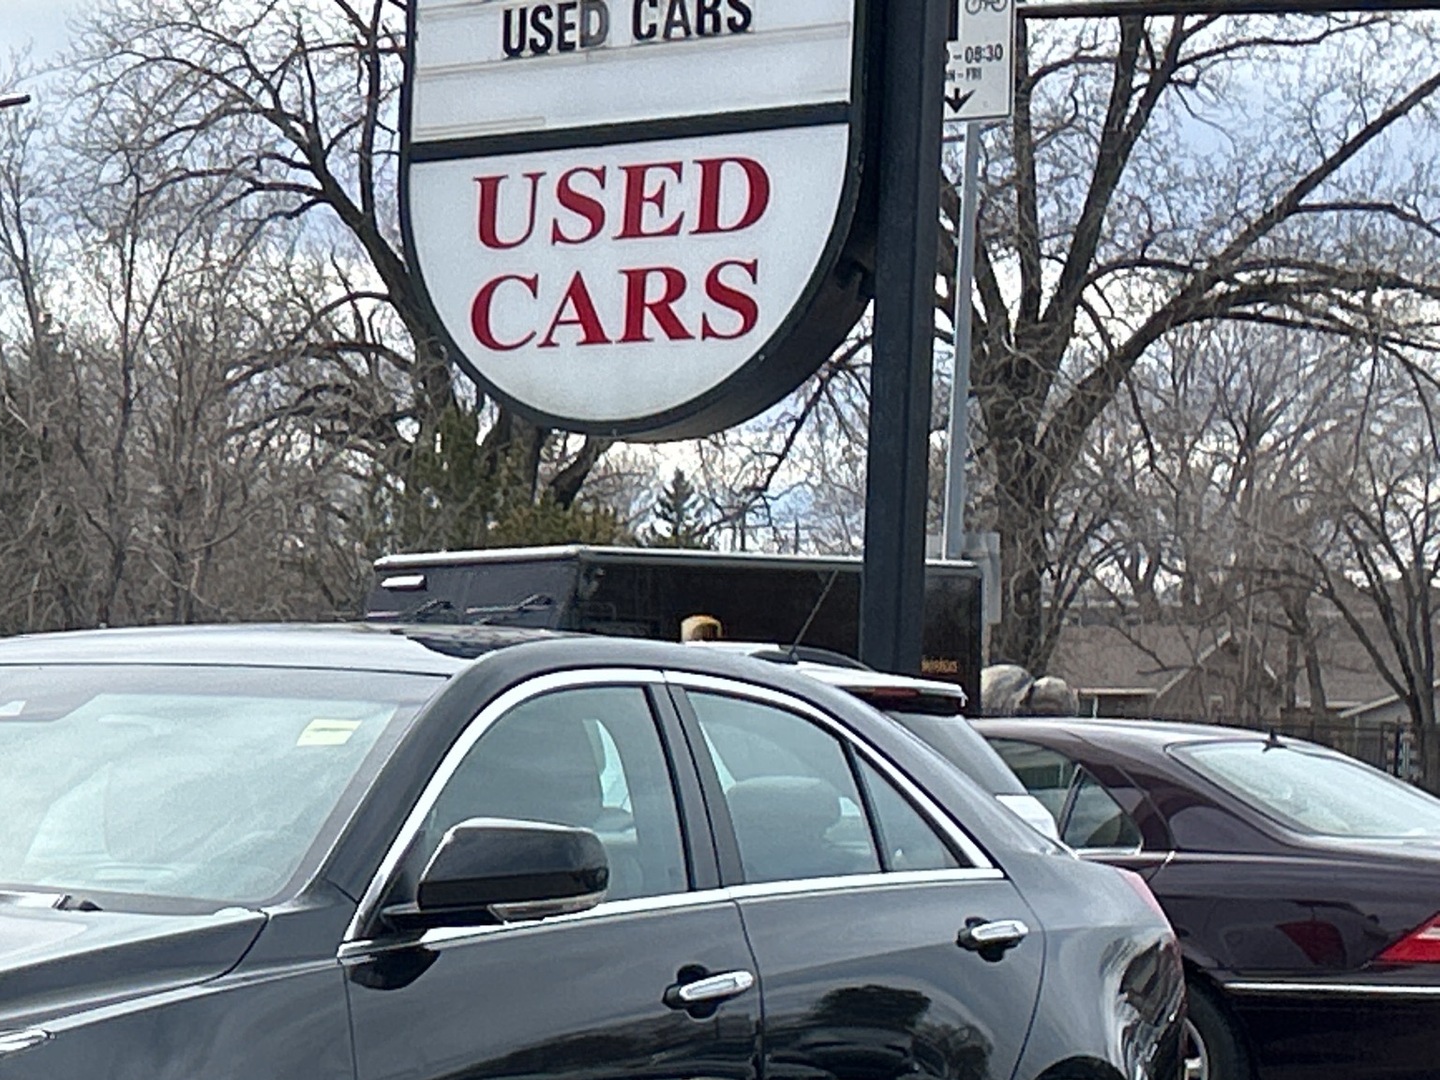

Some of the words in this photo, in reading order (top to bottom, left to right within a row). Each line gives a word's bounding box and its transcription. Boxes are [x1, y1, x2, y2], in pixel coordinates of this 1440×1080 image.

[502, 0, 609, 57] USED
[632, 0, 752, 41] CARS
[473, 157, 771, 249] USED
[470, 258, 758, 351] CARS
